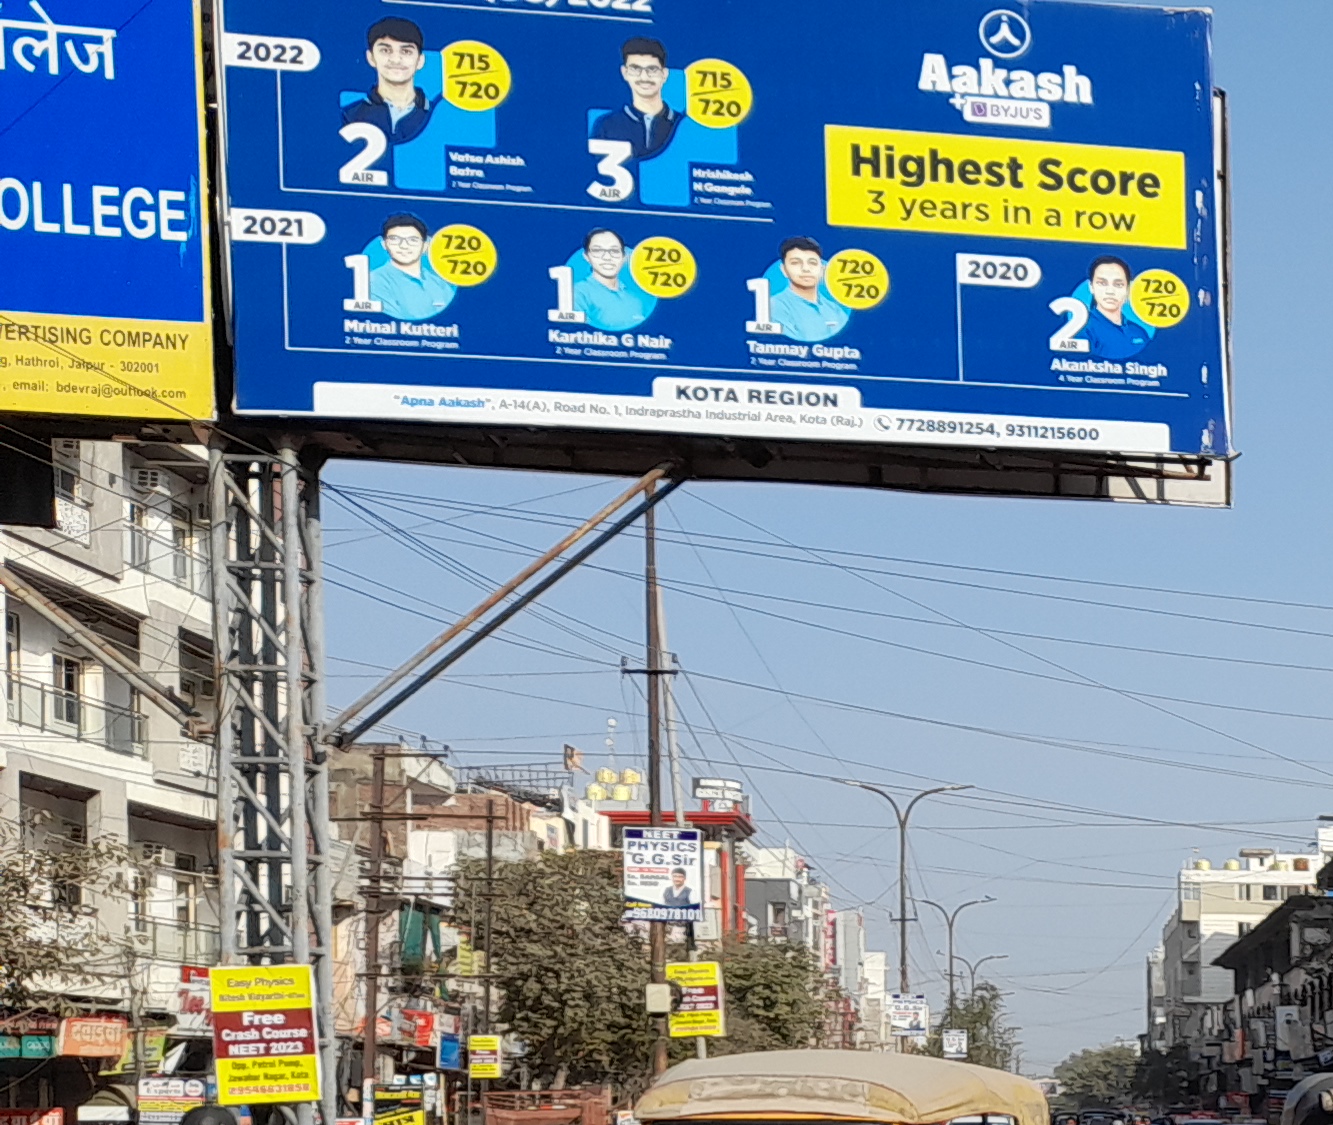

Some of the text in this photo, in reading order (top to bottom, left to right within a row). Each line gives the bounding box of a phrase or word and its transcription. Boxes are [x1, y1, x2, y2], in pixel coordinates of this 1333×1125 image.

[0, 0, 117, 80] लेज
[236, 41, 304, 65] 2022
[452, 52, 490, 71] 715
[695, 70, 732, 88] 715
[918, 52, 1093, 104] Aakash
[455, 81, 500, 100] 720
[698, 98, 741, 117] 720
[990, 102, 1044, 122] BYJU'S
[339, 122, 388, 186] 2
[351, 172, 374, 183] AIR
[586, 139, 635, 202] 3
[849, 144, 1162, 199] Highest Score
[599, 188, 621, 198] AIR
[866, 190, 1137, 232] 3 years in a row
[242, 215, 304, 237] 2021
[441, 234, 482, 251] 720
[642, 246, 682, 263] 720
[449, 259, 487, 276] 720
[836, 258, 875, 275] 720
[967, 260, 1029, 282] 2020
[649, 271, 687, 288] 720
[1140, 278, 1177, 295] 720
[842, 282, 880, 300] 720
[1145, 302, 1181, 318] 720
[343, 319, 459, 339] Mrinal Kutteri
[1048, 296, 1090, 352] 2
[99, 328, 190, 351] COMPANY
[548, 329, 672, 349] Karthika G Nair
[1059, 340, 1078, 350] AIR
[746, 340, 860, 361] Tanmay Gupta
[68, 360, 160, 373] Jaipur 302001
[1050, 358, 1168, 378] Akanksha Singh
[12, 380, 50, 392] email:
[675, 385, 839, 408] KOTA REGION
[498, 398, 550, 413] A-14(A),
[554, 402, 586, 414] Road
[589, 403, 611, 415] No.
[625, 405, 701, 420] Indraprastha
[705, 409, 761, 422] Industrial
[764, 412, 796, 425] Area,
[799, 413, 828, 425] Kota
[831, 415, 864, 429] (Raj.)
[895, 417, 1100, 442] 7728891254, 9311215600
[643, 829, 680, 838] NEET
[627, 840, 697, 852] PHYSICS
[631, 852, 697, 866] G.G.Sir
[227, 976, 295, 989] Easy Physics
[242, 1011, 287, 1026] Free
[221, 1027, 308, 1041] Crash Course
[228, 1041, 304, 1056] NEET 2023
